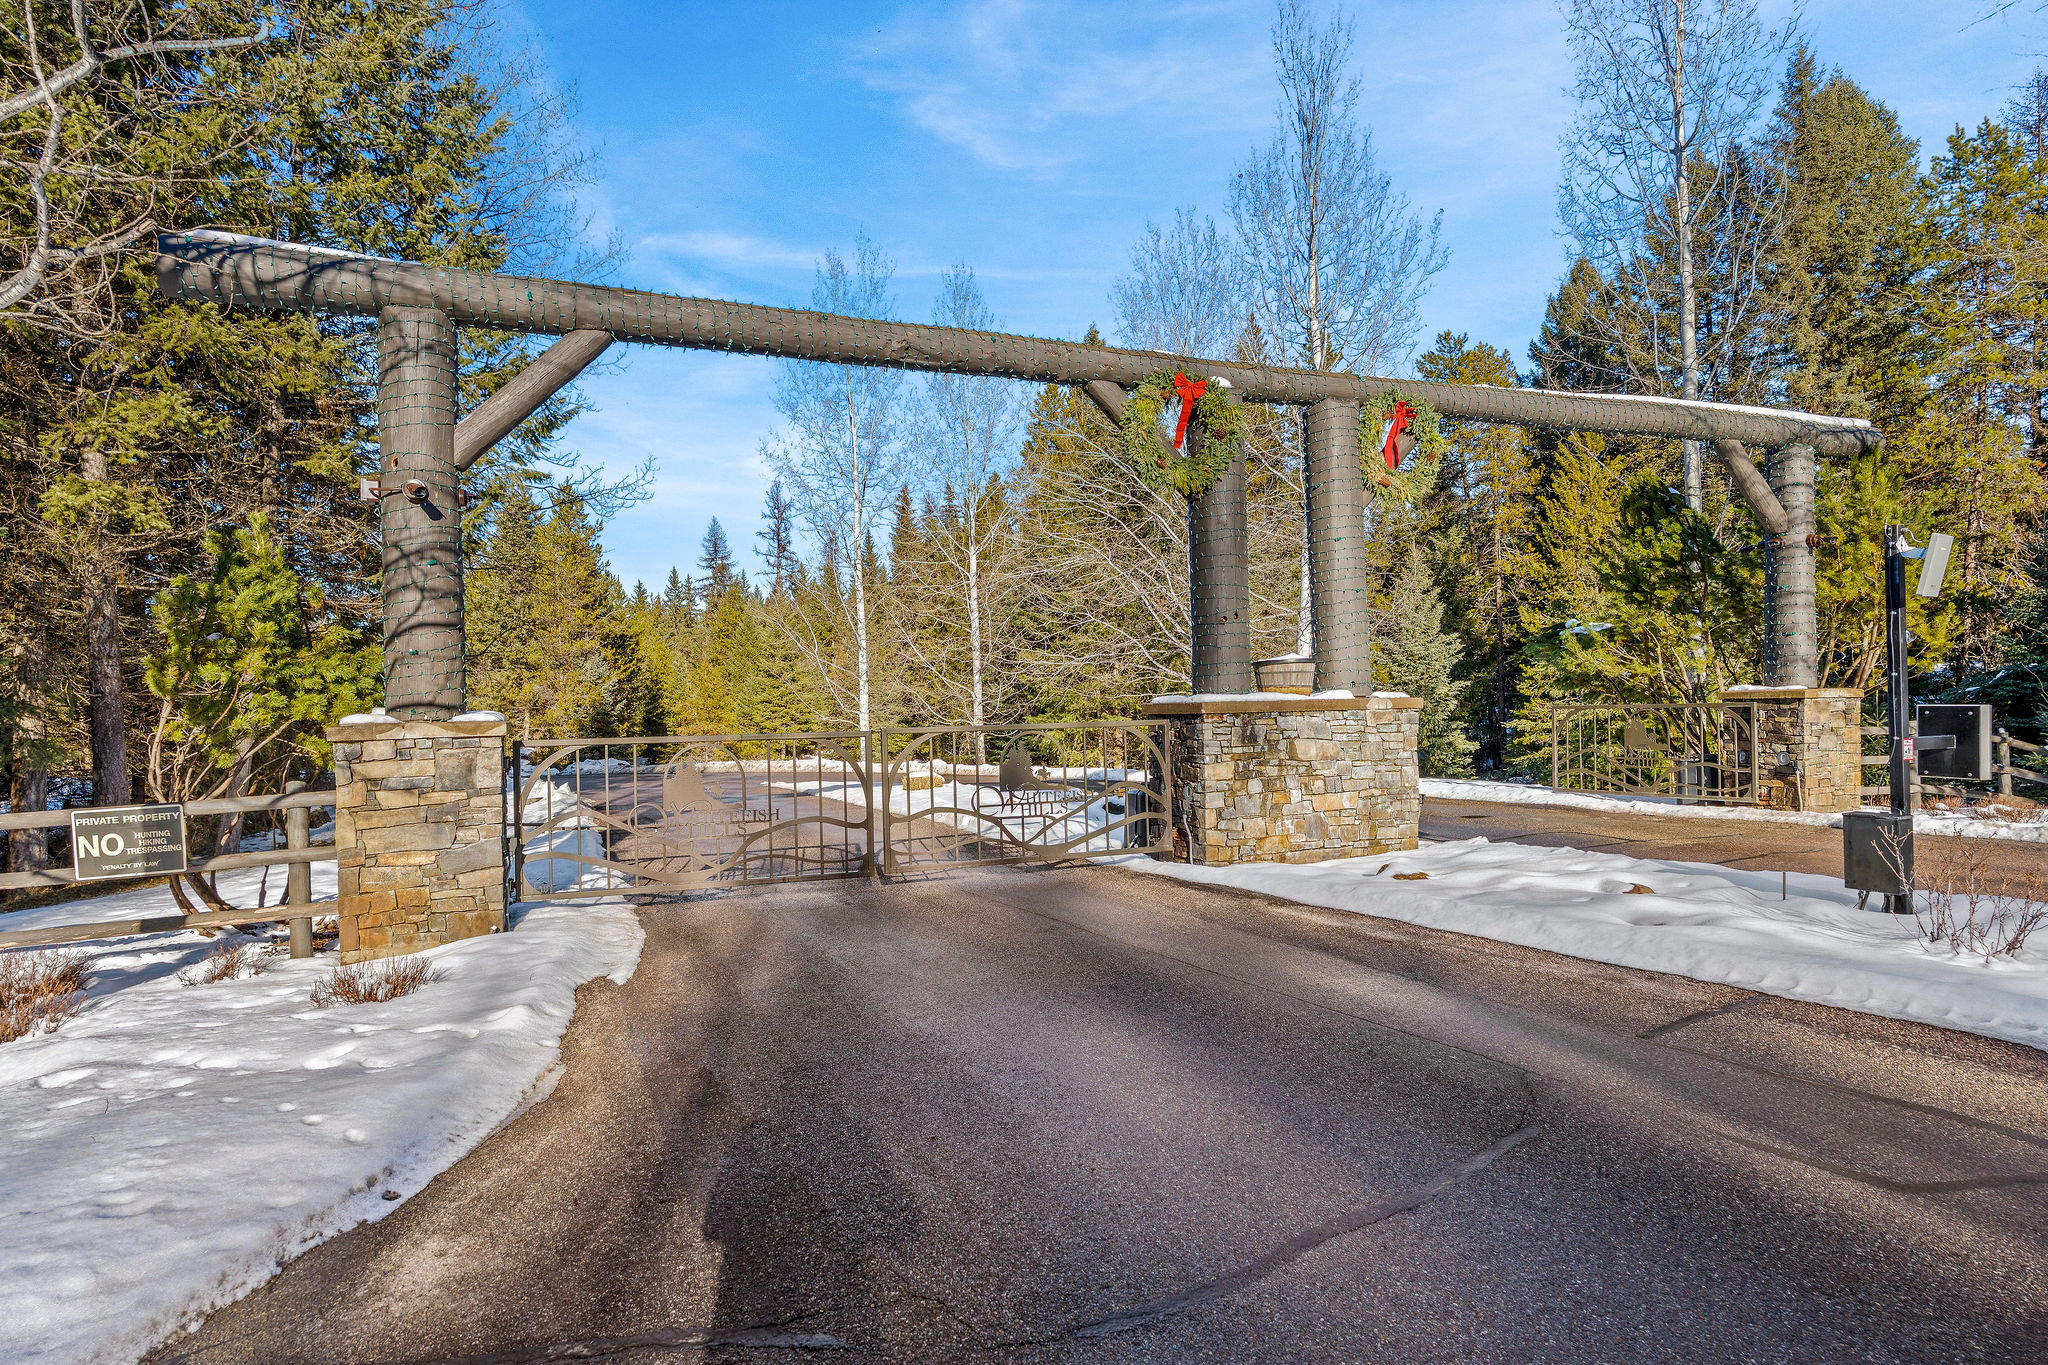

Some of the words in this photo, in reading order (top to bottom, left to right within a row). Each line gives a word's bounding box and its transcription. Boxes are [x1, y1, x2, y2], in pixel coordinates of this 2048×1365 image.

[1021, 801, 1069, 815] HILLS
[76, 816, 119, 826] PRIVATE
[123, 812, 180, 824] PROPERTY
[134, 830, 171, 839] HUNTING
[78, 833, 125, 858] NO
[138, 838, 167, 846] HIKING
[125, 844, 182, 855] TRESPASSING
